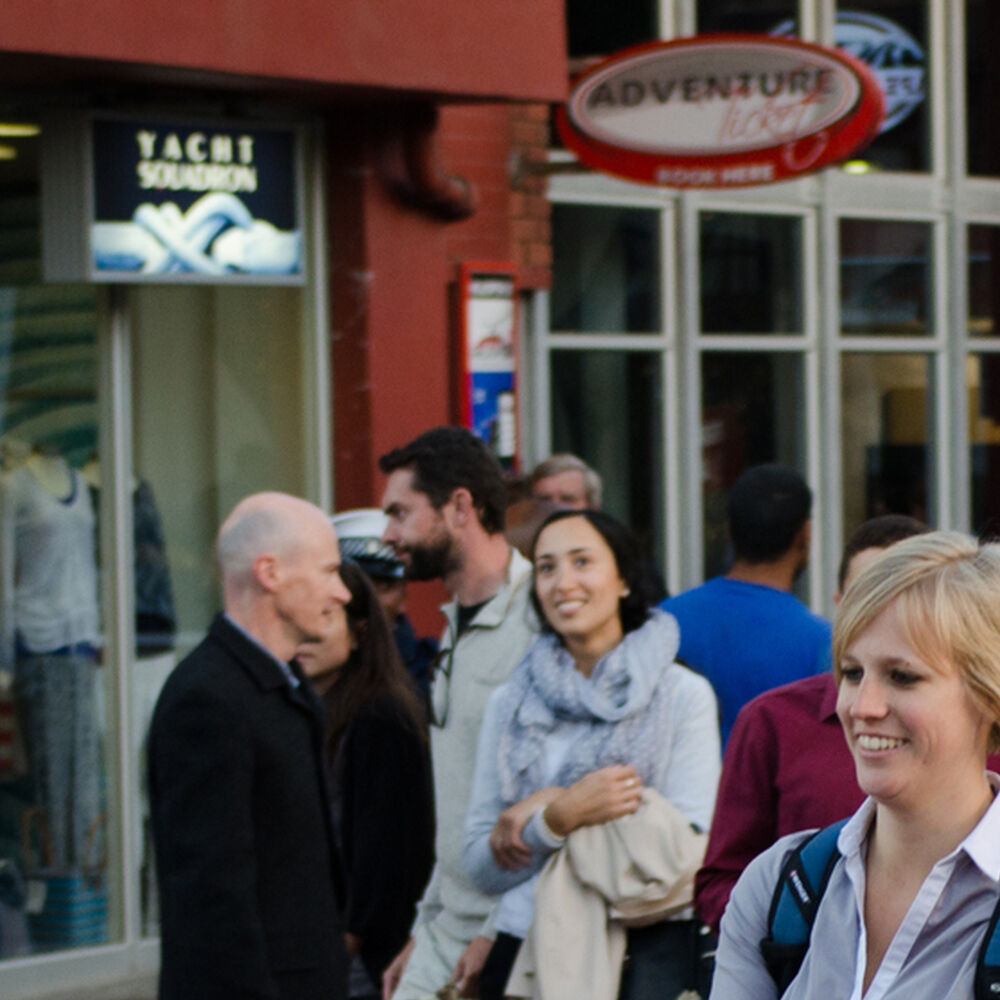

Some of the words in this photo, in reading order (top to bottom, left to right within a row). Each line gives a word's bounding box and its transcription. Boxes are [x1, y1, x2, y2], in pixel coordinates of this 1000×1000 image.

[589, 68, 834, 109] ADVENTURE
[137, 131, 253, 163] YACHT
[138, 161, 257, 192] SQUADRON
